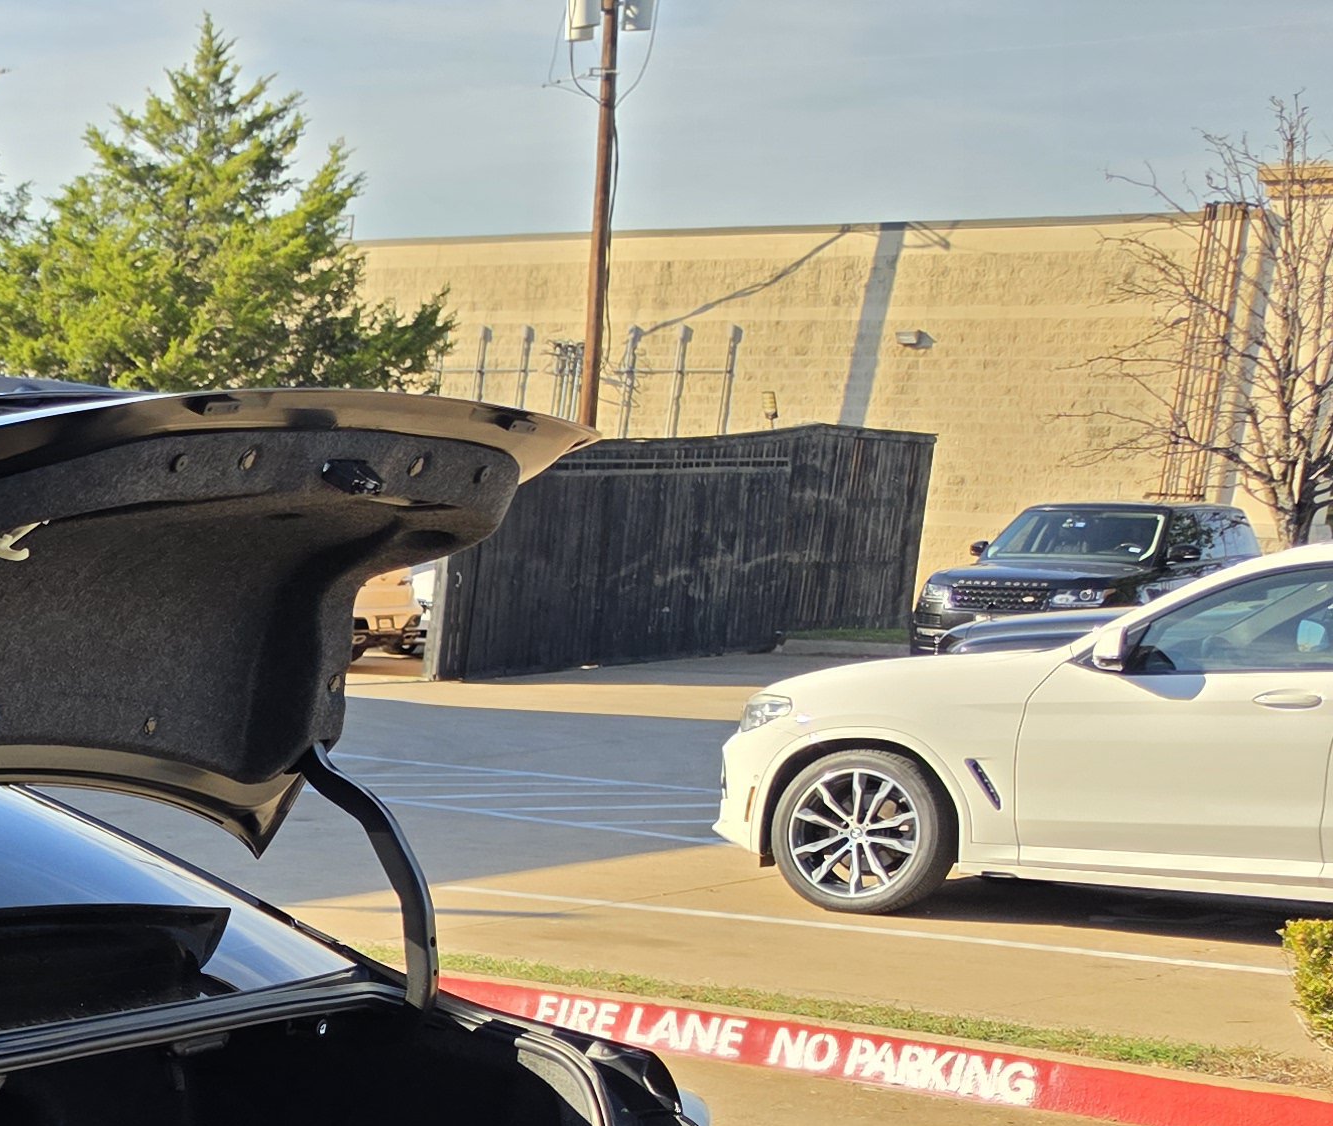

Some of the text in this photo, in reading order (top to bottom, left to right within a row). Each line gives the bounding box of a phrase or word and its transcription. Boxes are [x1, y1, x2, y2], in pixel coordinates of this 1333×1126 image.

[533, 994, 1039, 1107] FIRE LANE NO PARKING
